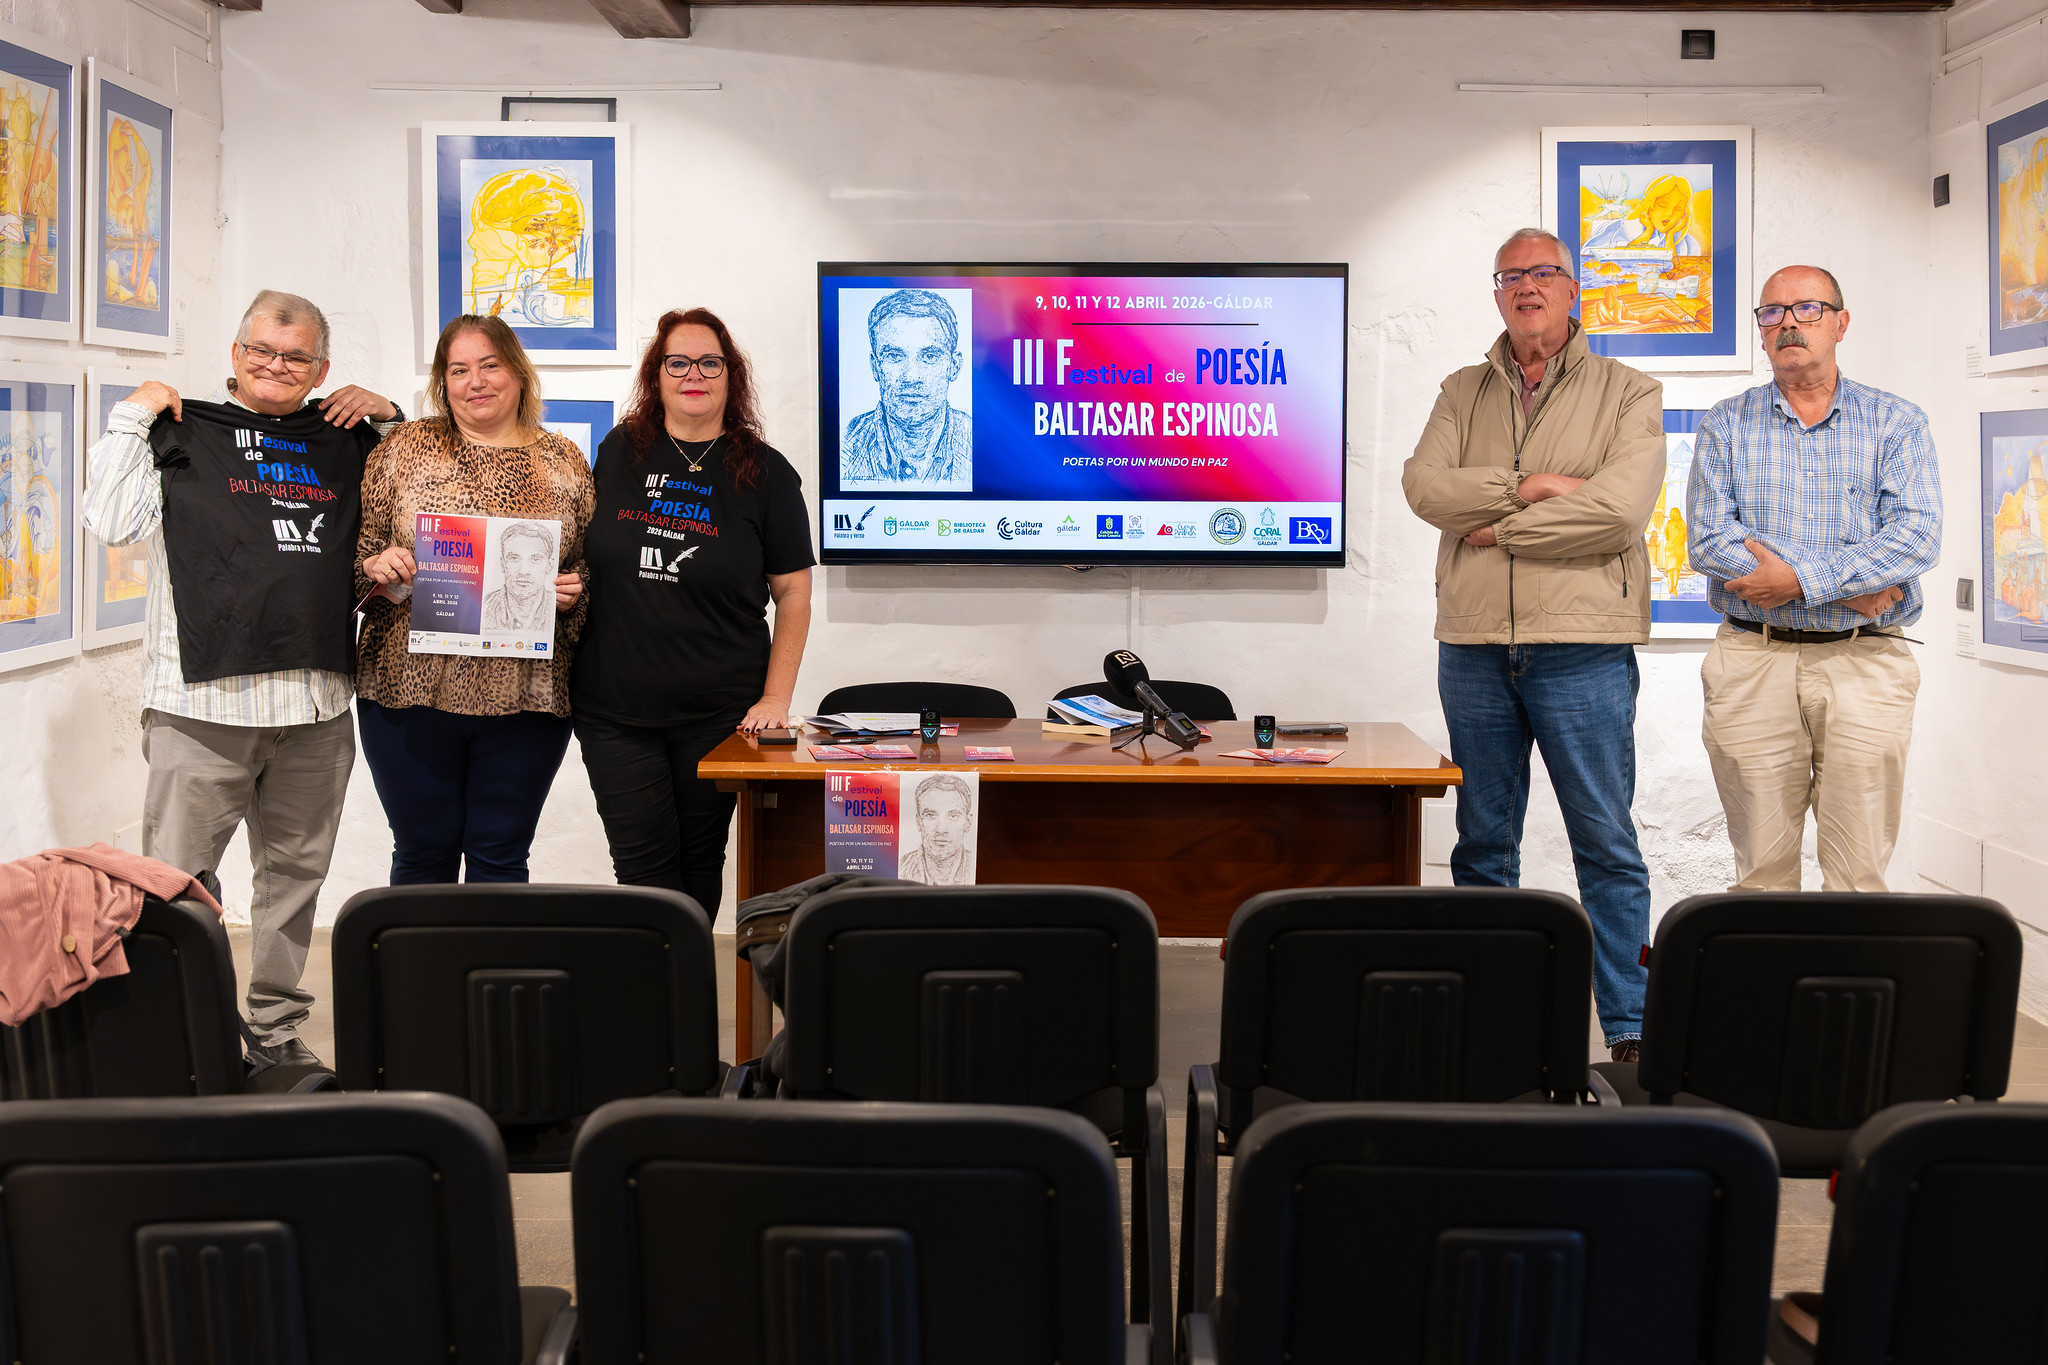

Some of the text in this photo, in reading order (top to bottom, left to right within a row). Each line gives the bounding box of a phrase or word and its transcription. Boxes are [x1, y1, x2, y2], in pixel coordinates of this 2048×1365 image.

[1035, 296, 1047, 310] 9,
[1052, 296, 1071, 310] 10,
[1075, 296, 1087, 309] 11
[1092, 296, 1102, 309] Y
[1107, 296, 1120, 309] 12
[1125, 296, 1167, 309] ABRIL
[1013, 339, 1287, 385] III Festival de POESÍA
[1034, 402, 1278, 436] BALTASAR ESPINOSA
[235, 429, 307, 453] III Festival
[245, 449, 263, 461] de
[1063, 457, 1228, 467] POETAS POR UN MUNDO EN PAZ
[257, 462, 321, 487] POESÍA
[229, 478, 338, 501] BALTASAR ESPINOSA
[645, 474, 713, 496] III Festival
[647, 489, 662, 498] de
[649, 499, 711, 522] POESÍA
[421, 518, 470, 537] III Festival
[617, 509, 719, 538] BALTASAR ESPINOSA
[1014, 520, 1043, 528] Cultura
[1057, 525, 1080, 533] gáldar
[422, 534, 433, 542] de
[647, 526, 685, 540] 2026 GÁLDAR
[1253, 527, 1281, 537] CORAL
[278, 543, 301, 552] Palabra
[433, 539, 474, 558] POESÍA
[418, 561, 480, 575] BALTASAR ESPINOSA
[639, 570, 679, 583] Palabra y Verso
[831, 775, 883, 795] III Festival
[832, 794, 843, 803] de
[845, 797, 888, 818] POESÍA
[829, 824, 894, 835] BALTASAR ESPINOSA
